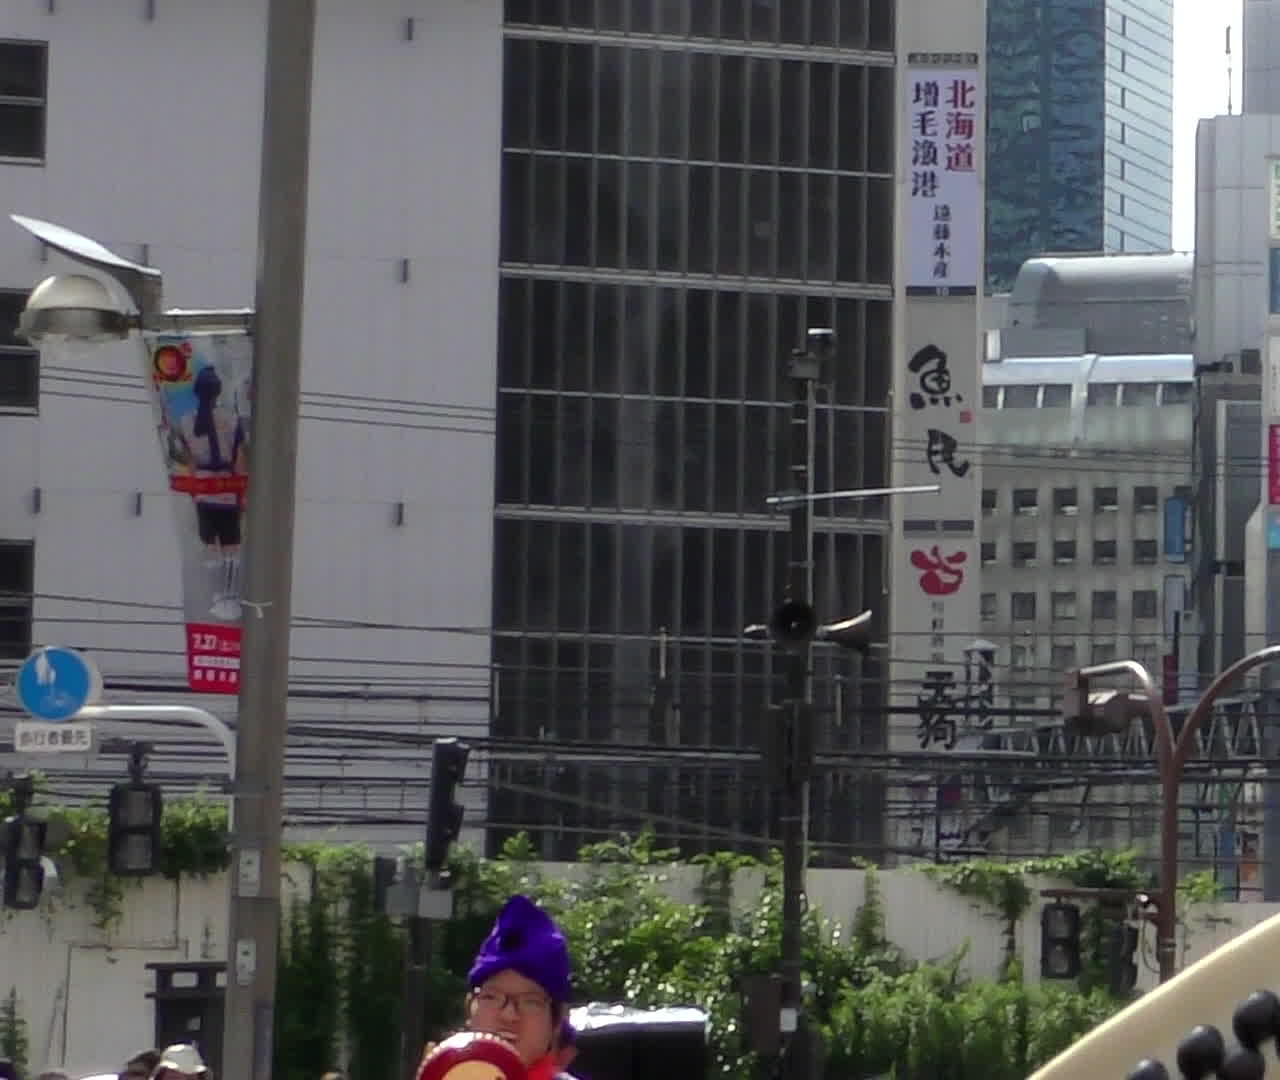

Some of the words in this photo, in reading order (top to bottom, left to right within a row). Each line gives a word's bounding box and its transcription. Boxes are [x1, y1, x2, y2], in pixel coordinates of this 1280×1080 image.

[945, 79, 977, 172] 北海道
[907, 344, 971, 478] 魚民
[917, 670, 957, 750] 天狗
